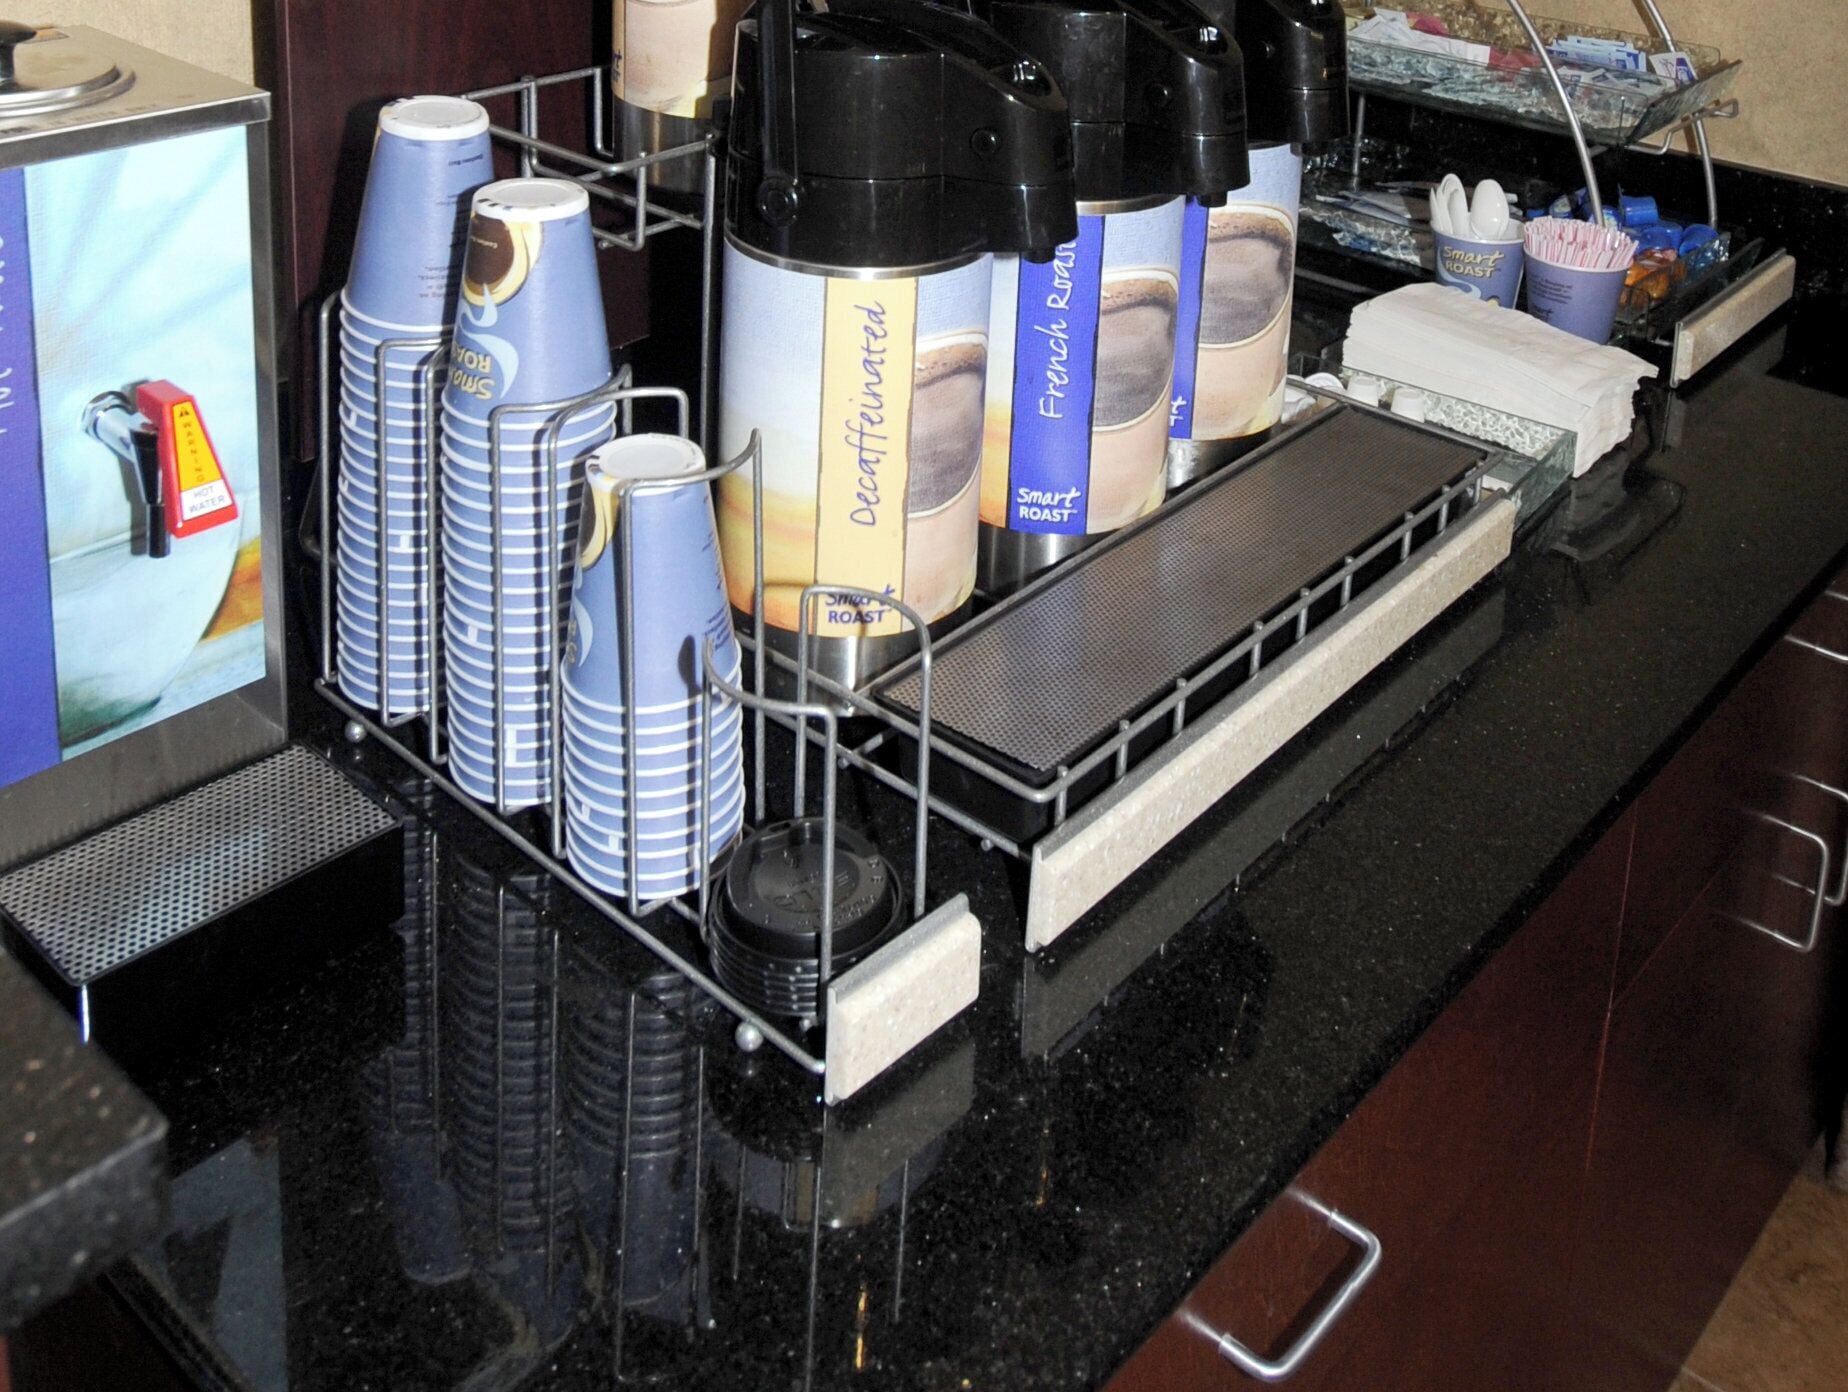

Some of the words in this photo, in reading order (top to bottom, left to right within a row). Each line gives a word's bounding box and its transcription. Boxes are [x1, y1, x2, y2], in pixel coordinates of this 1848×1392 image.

[1443, 245, 1505, 267] Smart
[1445, 260, 1495, 278] ROAST
[453, 346, 491, 374] ROA
[1033, 317, 1070, 419] French
[451, 369, 496, 400] Sma
[845, 300, 889, 527] Decaffeinated
[182, 421, 206, 483] WARNING
[193, 485, 215, 498] HOT
[1016, 486, 1081, 508] Smart
[189, 494, 226, 514] WATER
[1019, 505, 1070, 523] ROAST
[827, 609, 886, 625] ROAST
